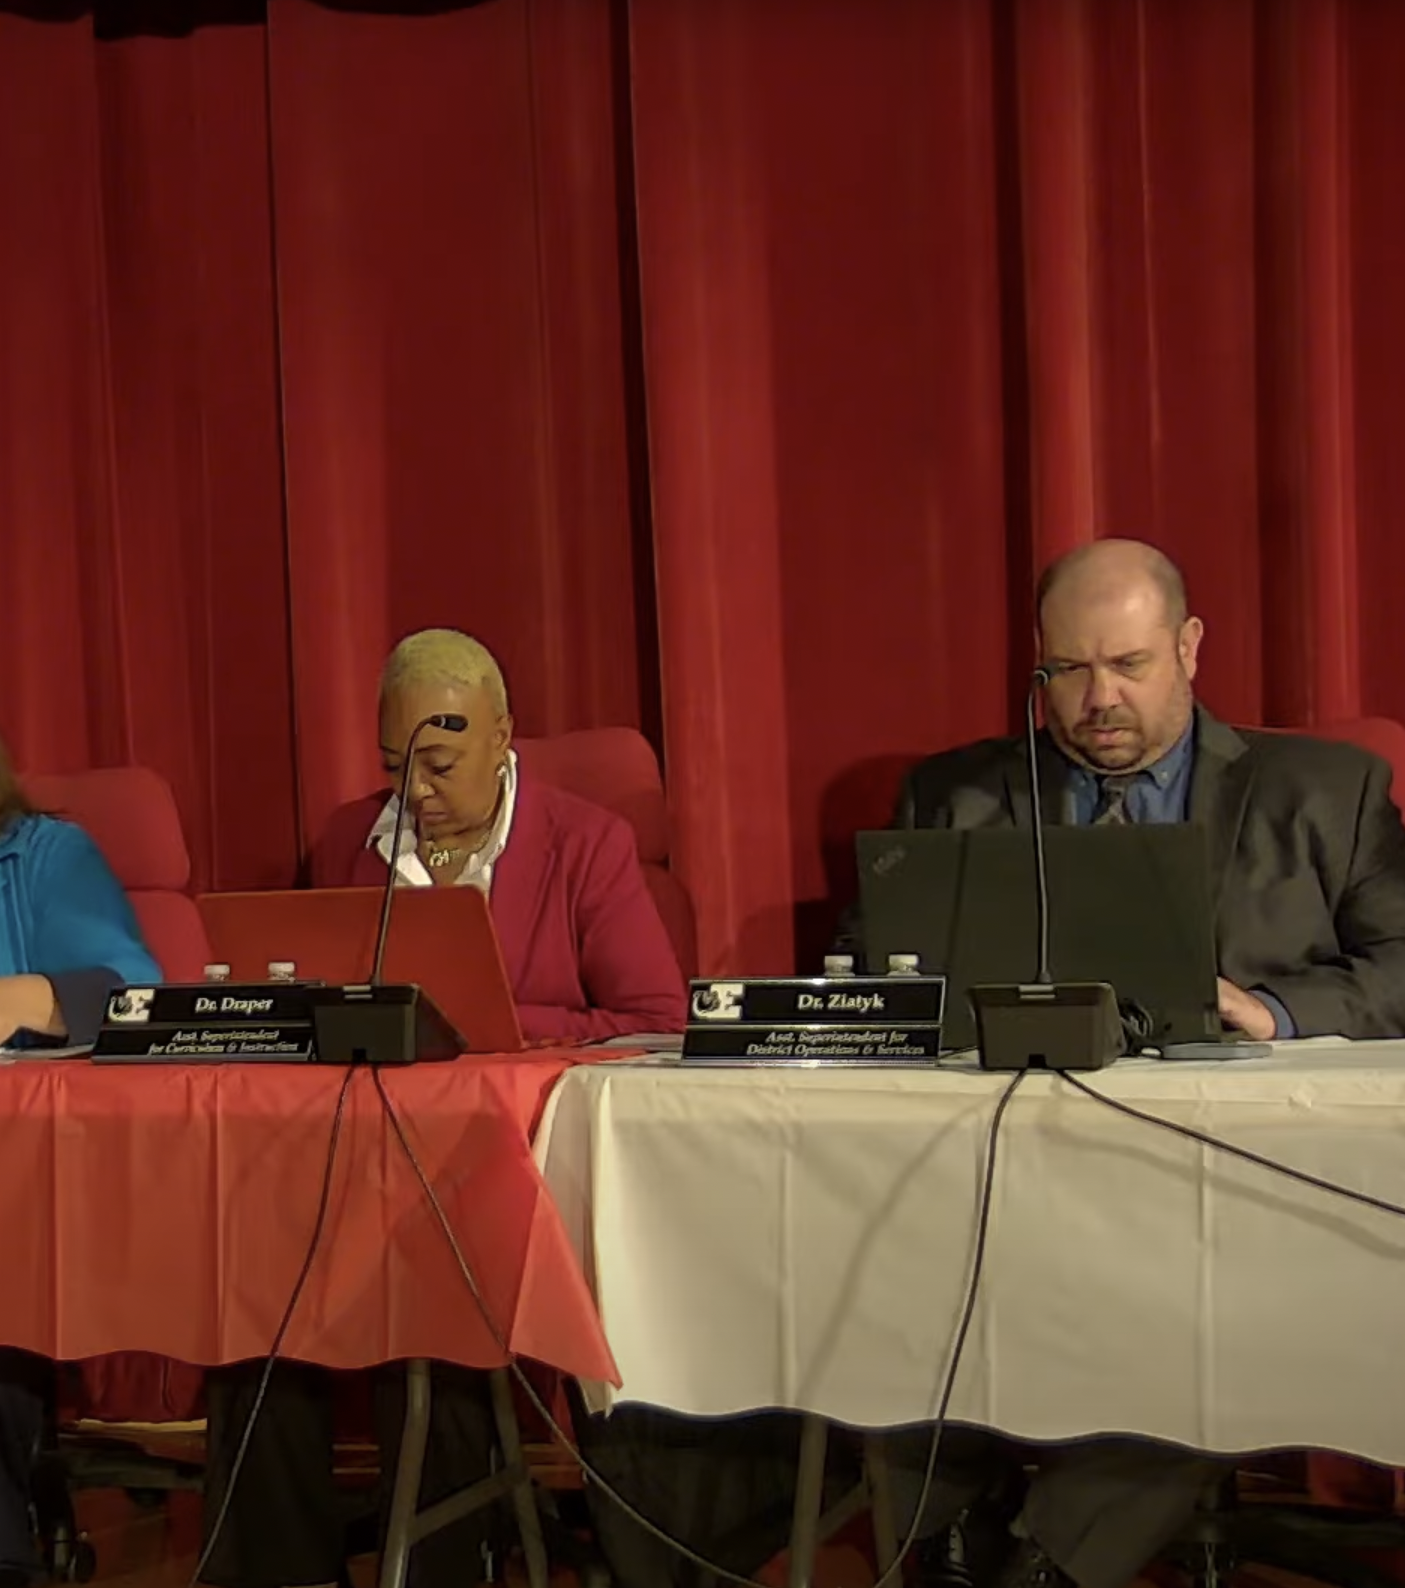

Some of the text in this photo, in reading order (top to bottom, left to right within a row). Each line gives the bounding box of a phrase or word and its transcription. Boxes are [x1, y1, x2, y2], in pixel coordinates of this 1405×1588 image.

[195, 997, 273, 1015] Dr. Draper
[797, 993, 885, 1014] Dr. Ziatyk
[172, 1029, 279, 1043] Asst. Superintendent
[765, 1031, 909, 1044] Asst. Superintendent for
[148, 1041, 299, 1055] for Curriculum & Instruction
[746, 1043, 925, 1057] District Operations & Services
